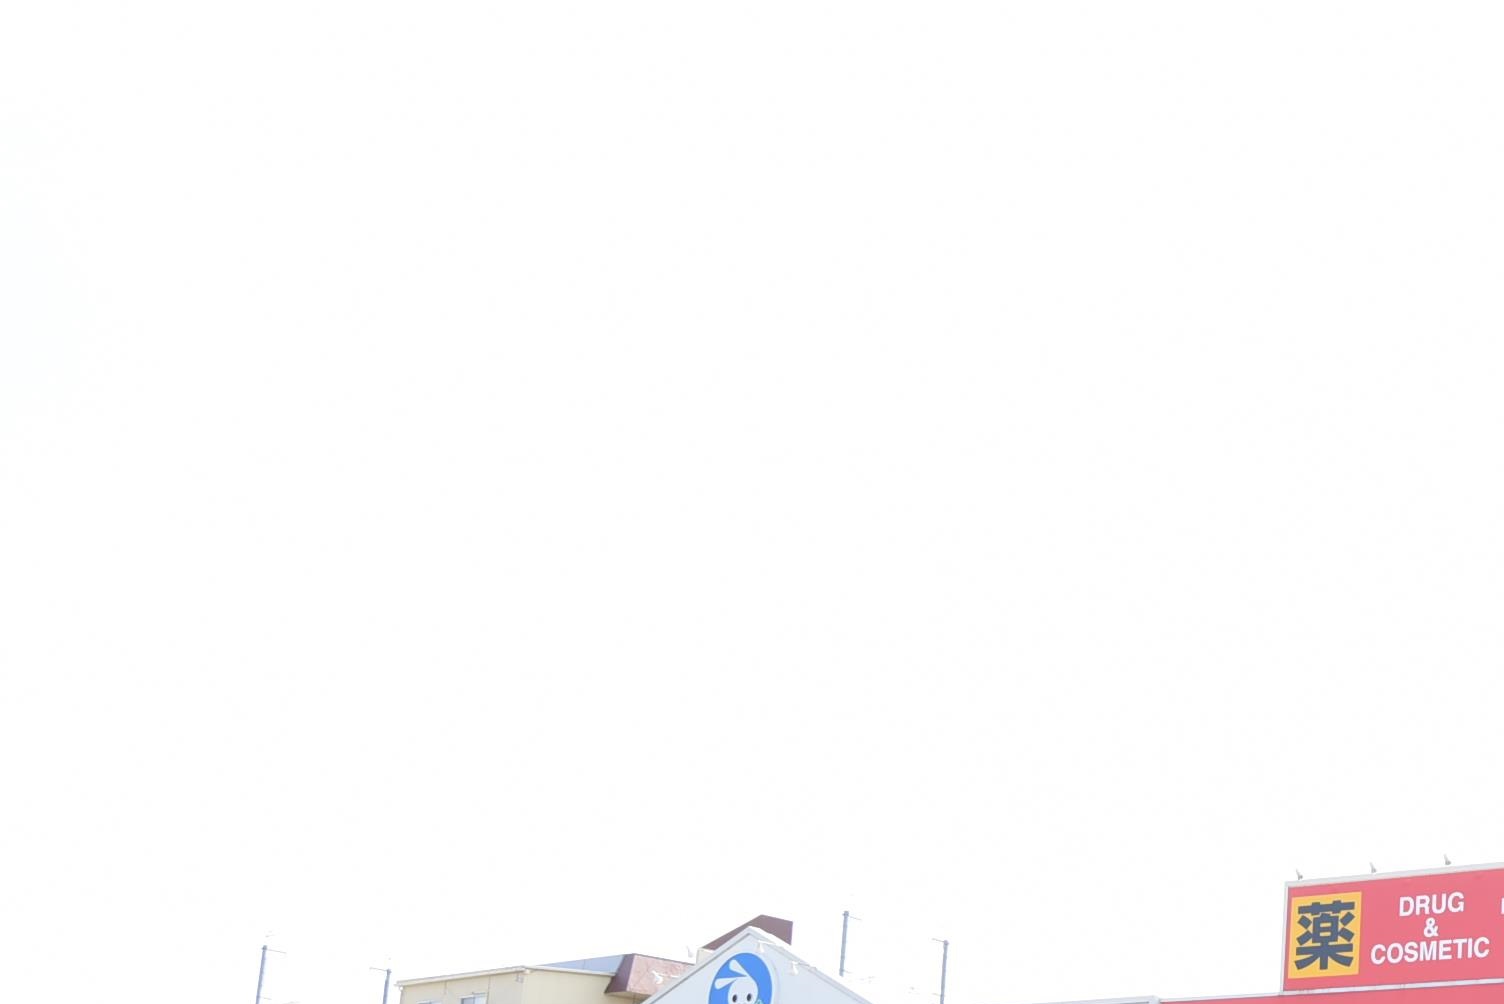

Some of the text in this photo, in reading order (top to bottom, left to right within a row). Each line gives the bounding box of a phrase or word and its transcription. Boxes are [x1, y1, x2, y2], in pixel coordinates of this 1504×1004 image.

[1399, 891, 1465, 917] DRUG
[1294, 900, 1356, 970] 薬
[1423, 917, 1439, 938] &
[1370, 936, 1490, 965] COSMETIC
